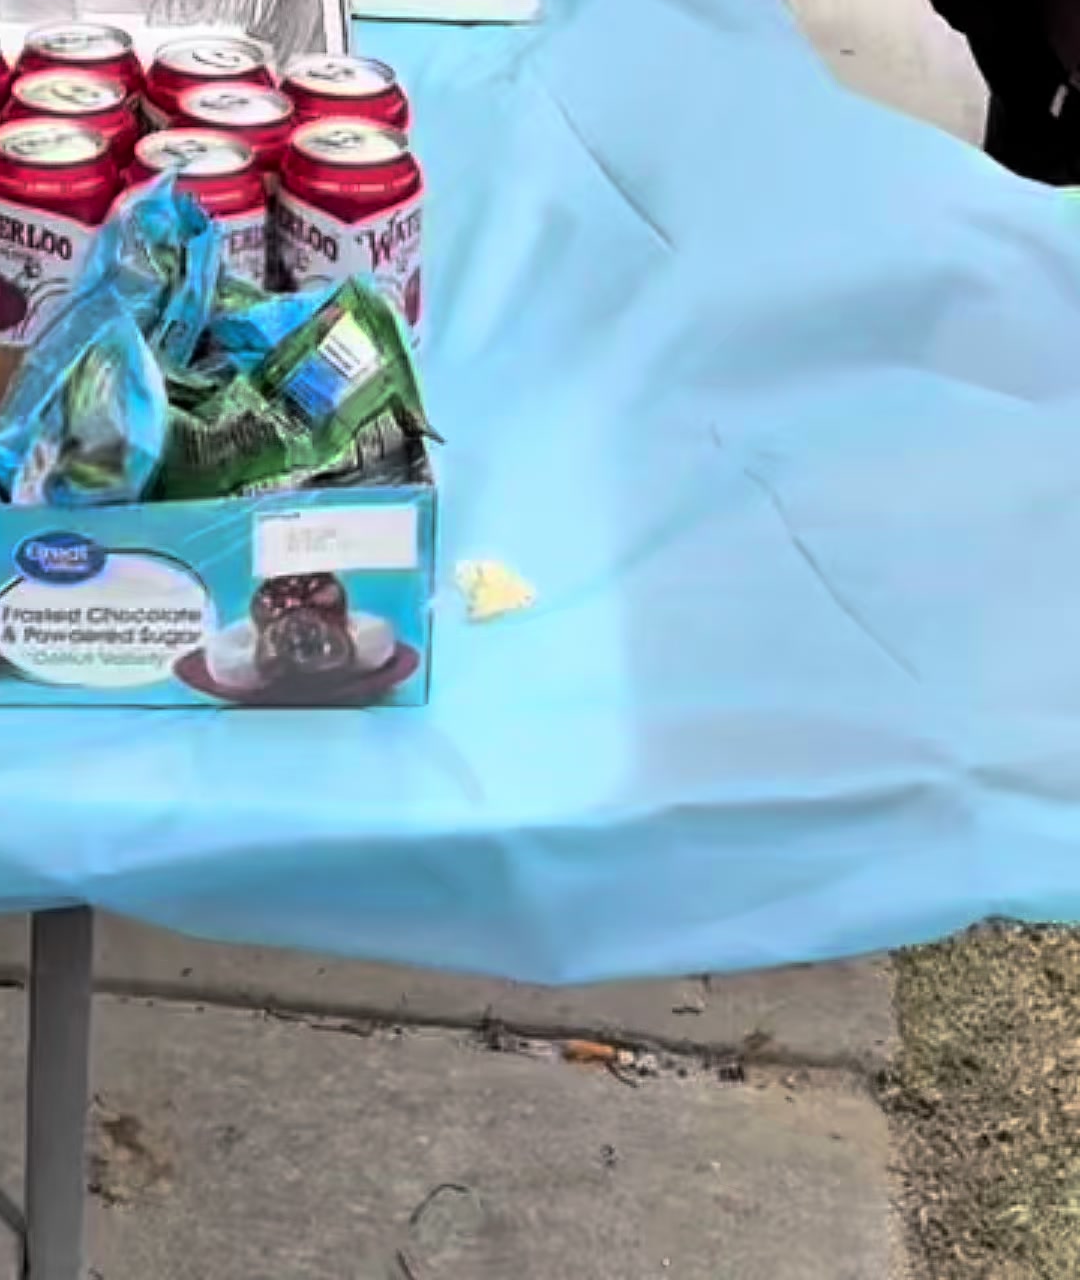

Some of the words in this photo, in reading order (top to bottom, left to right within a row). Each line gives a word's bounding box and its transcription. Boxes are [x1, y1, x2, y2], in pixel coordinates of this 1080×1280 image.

[3, 606, 81, 623] Frosted
[87, 606, 203, 624] Chocolate
[23, 626, 133, 644] Powdered
[139, 626, 203, 649] Sugar
